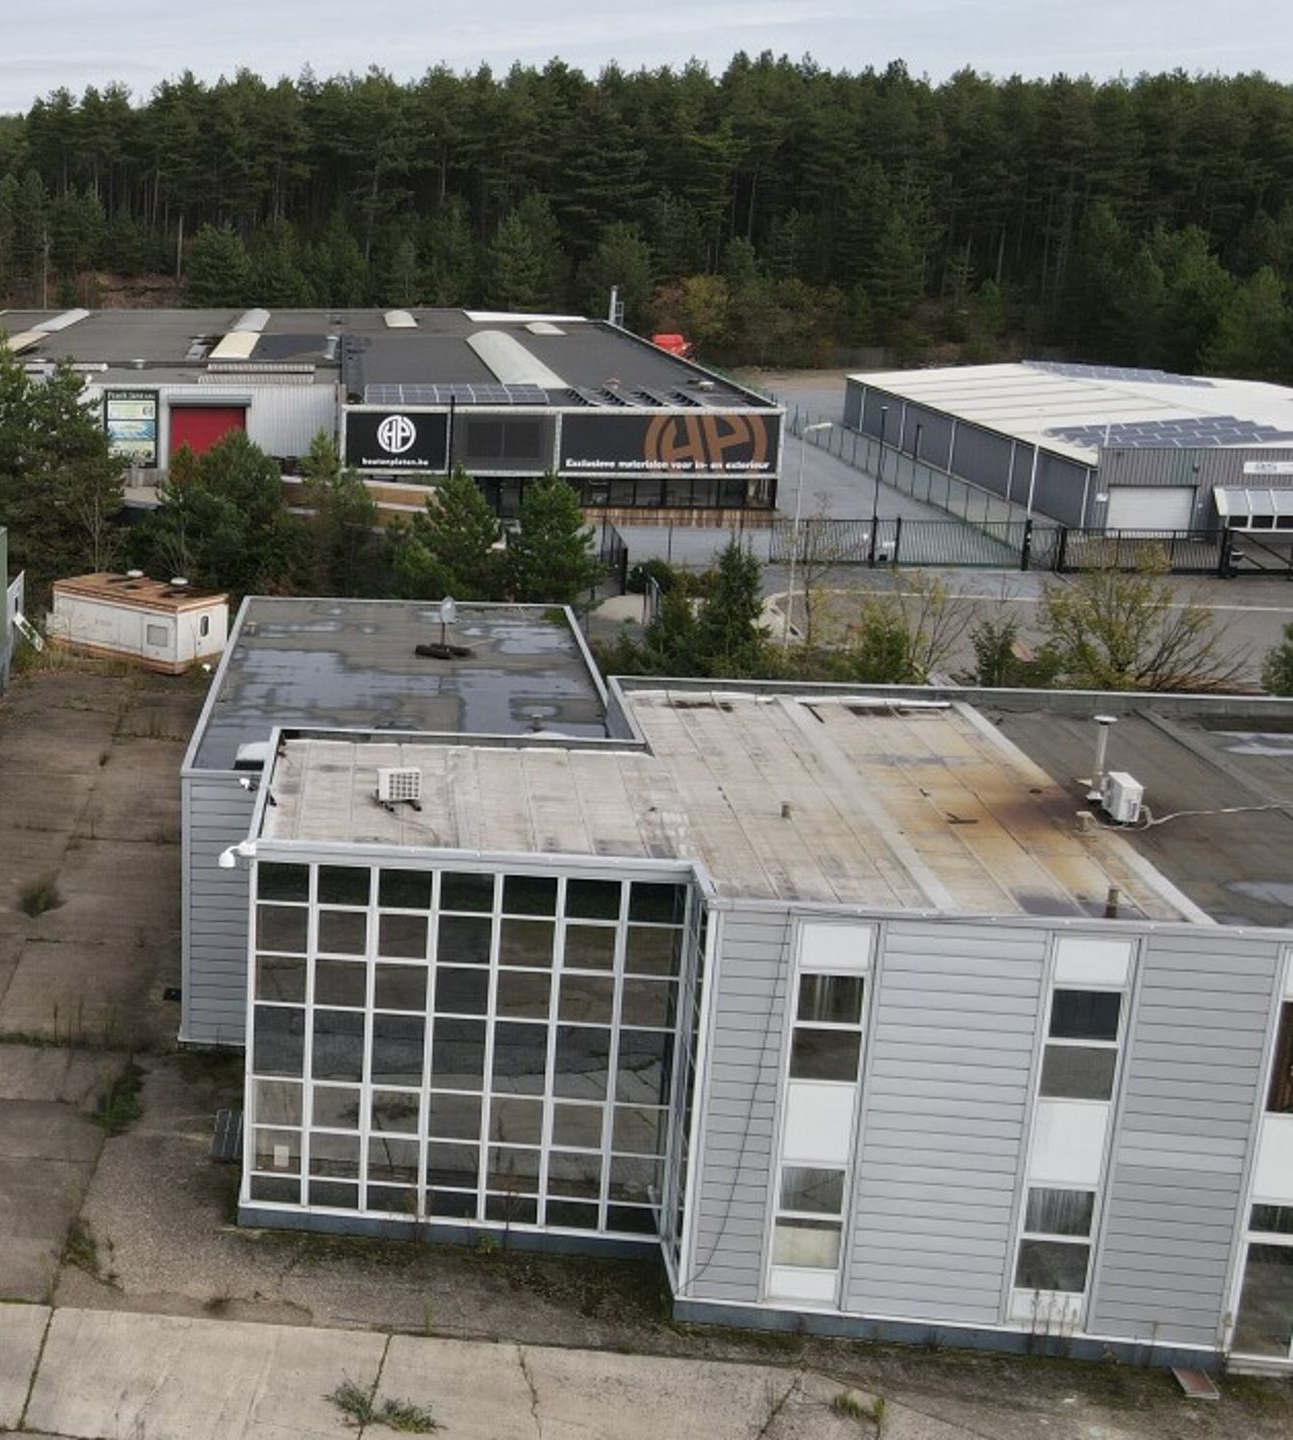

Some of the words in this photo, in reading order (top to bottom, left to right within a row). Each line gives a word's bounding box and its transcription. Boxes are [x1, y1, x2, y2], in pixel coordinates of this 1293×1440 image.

[565, 458, 615, 468] Exclusieve
[618, 459, 669, 469] materialen
[670, 461, 692, 469] voor
[710, 461, 723, 469] en
[725, 460, 769, 469] exterieur
